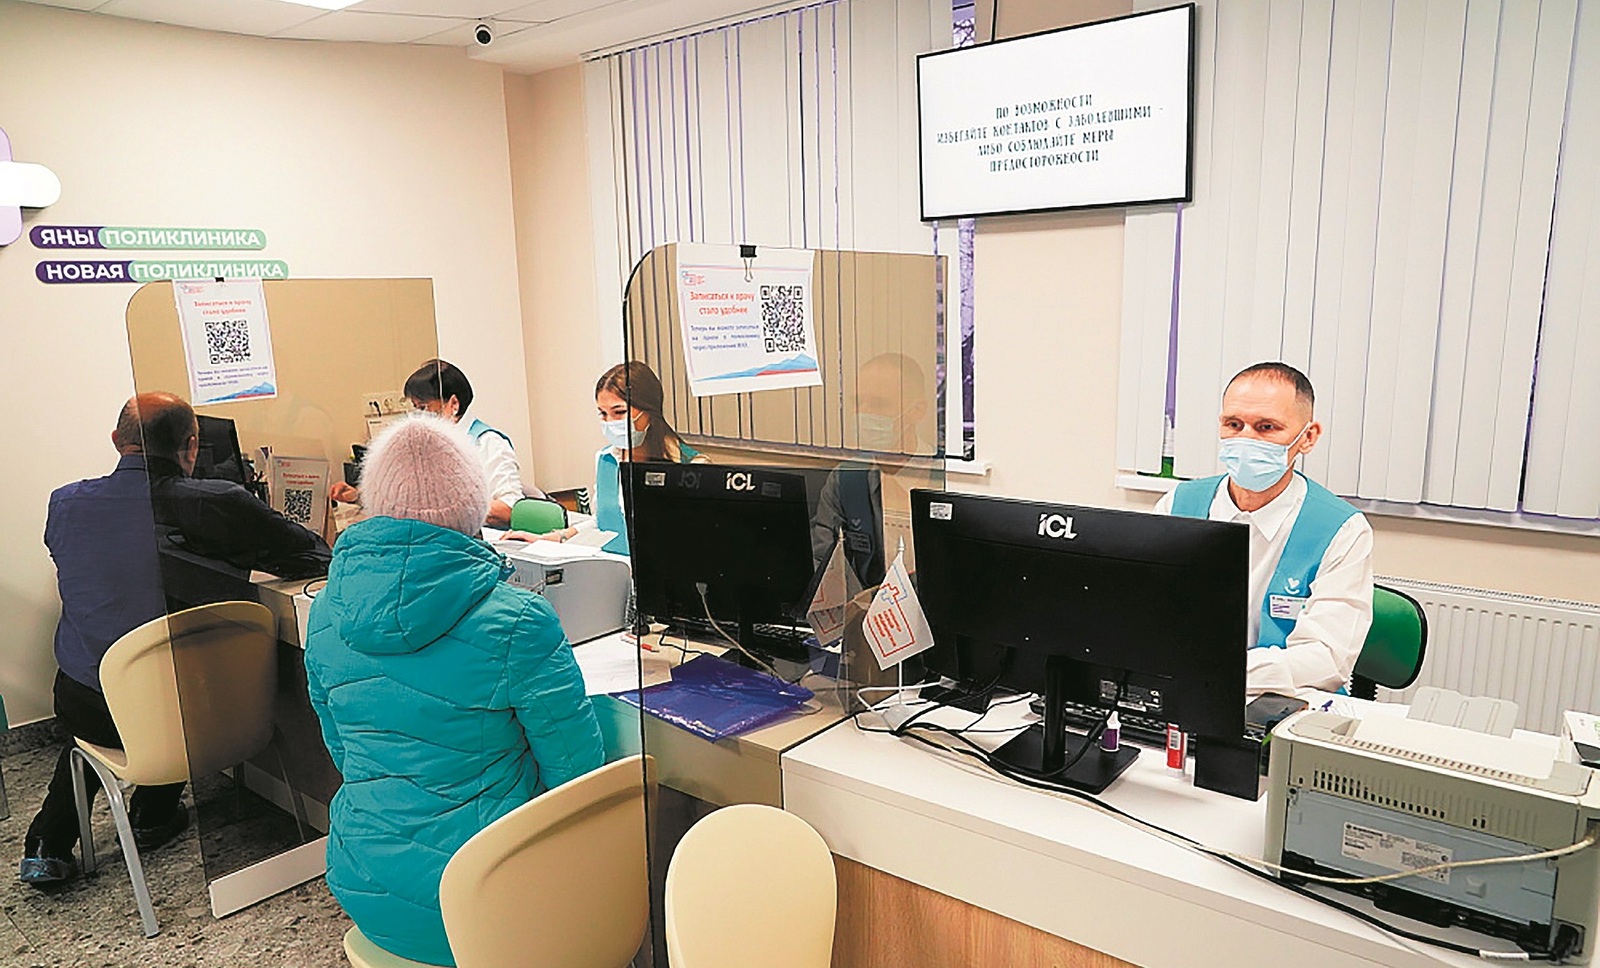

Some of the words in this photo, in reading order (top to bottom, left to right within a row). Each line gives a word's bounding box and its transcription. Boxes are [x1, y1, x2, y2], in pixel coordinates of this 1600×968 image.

[996, 107, 1009, 119] ПО
[1015, 94, 1092, 117] ВОЗМОЖНОСТИ
[937, 127, 987, 144] ИЗБЕГАЙТЕ
[993, 119, 1048, 137] КОНТАКТОВ
[1056, 117, 1061, 129] С
[1069, 105, 1151, 127] ЗАБОЛЕВШИМИ
[977, 143, 1003, 156] ЛИБО
[1008, 133, 1075, 152] СОБЛЮДАЙТЕ
[1083, 129, 1113, 144] МЕРЫ
[990, 149, 1099, 172] ПРЕДОСТОРОЖНОСТИ
[40, 229, 95, 246] ЯҢЫ
[105, 230, 260, 246] ПОЛИКЛИНИКА
[46, 264, 124, 280] НОВАЯ
[134, 263, 284, 278] ПОЛИКЛИНИКА
[690, 291, 729, 301] Записаться
[699, 307, 719, 315] стало
